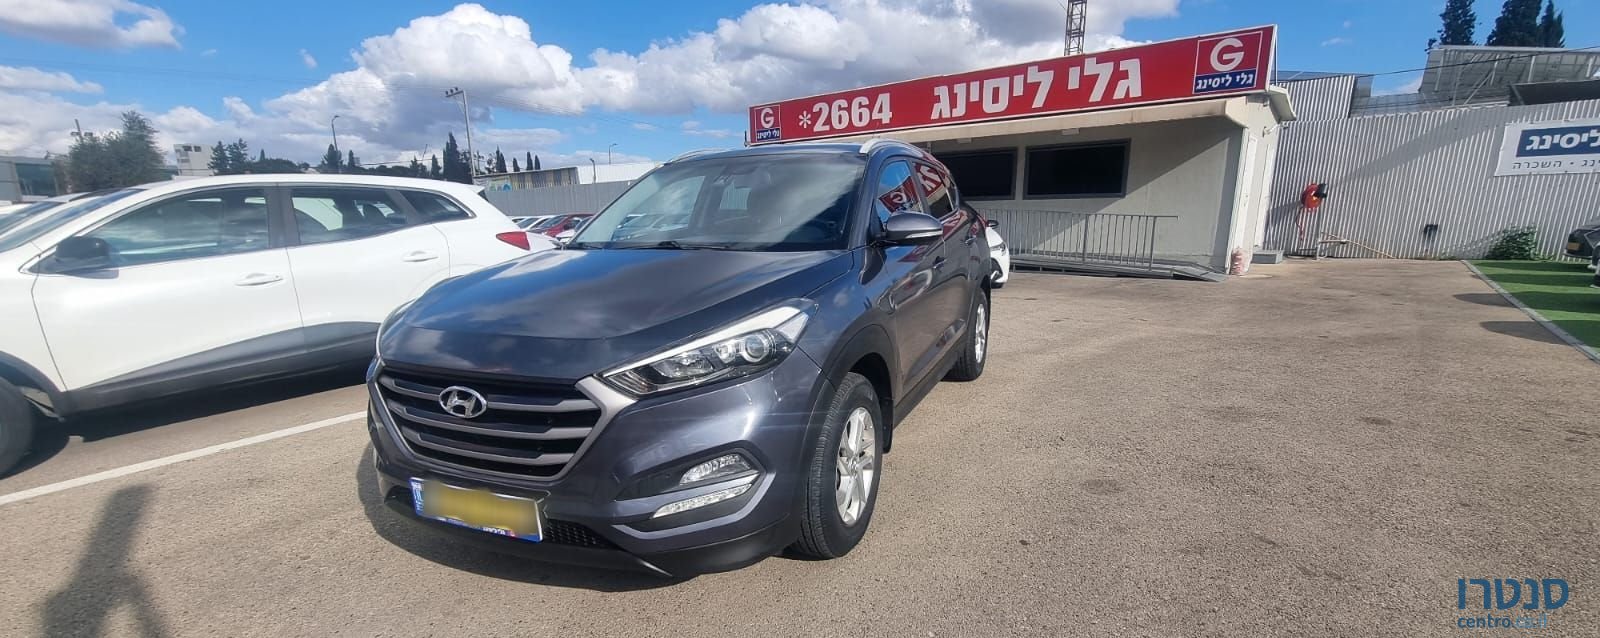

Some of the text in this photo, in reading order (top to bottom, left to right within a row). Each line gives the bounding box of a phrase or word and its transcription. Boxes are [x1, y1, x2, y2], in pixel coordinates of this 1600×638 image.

[1210, 37, 1245, 72] G
[930, 57, 1142, 120] גלי ליסינג
[1195, 72, 1255, 90] גלי ליסינג
[760, 107, 775, 129] G
[1511, 160, 1562, 169] השכרה
